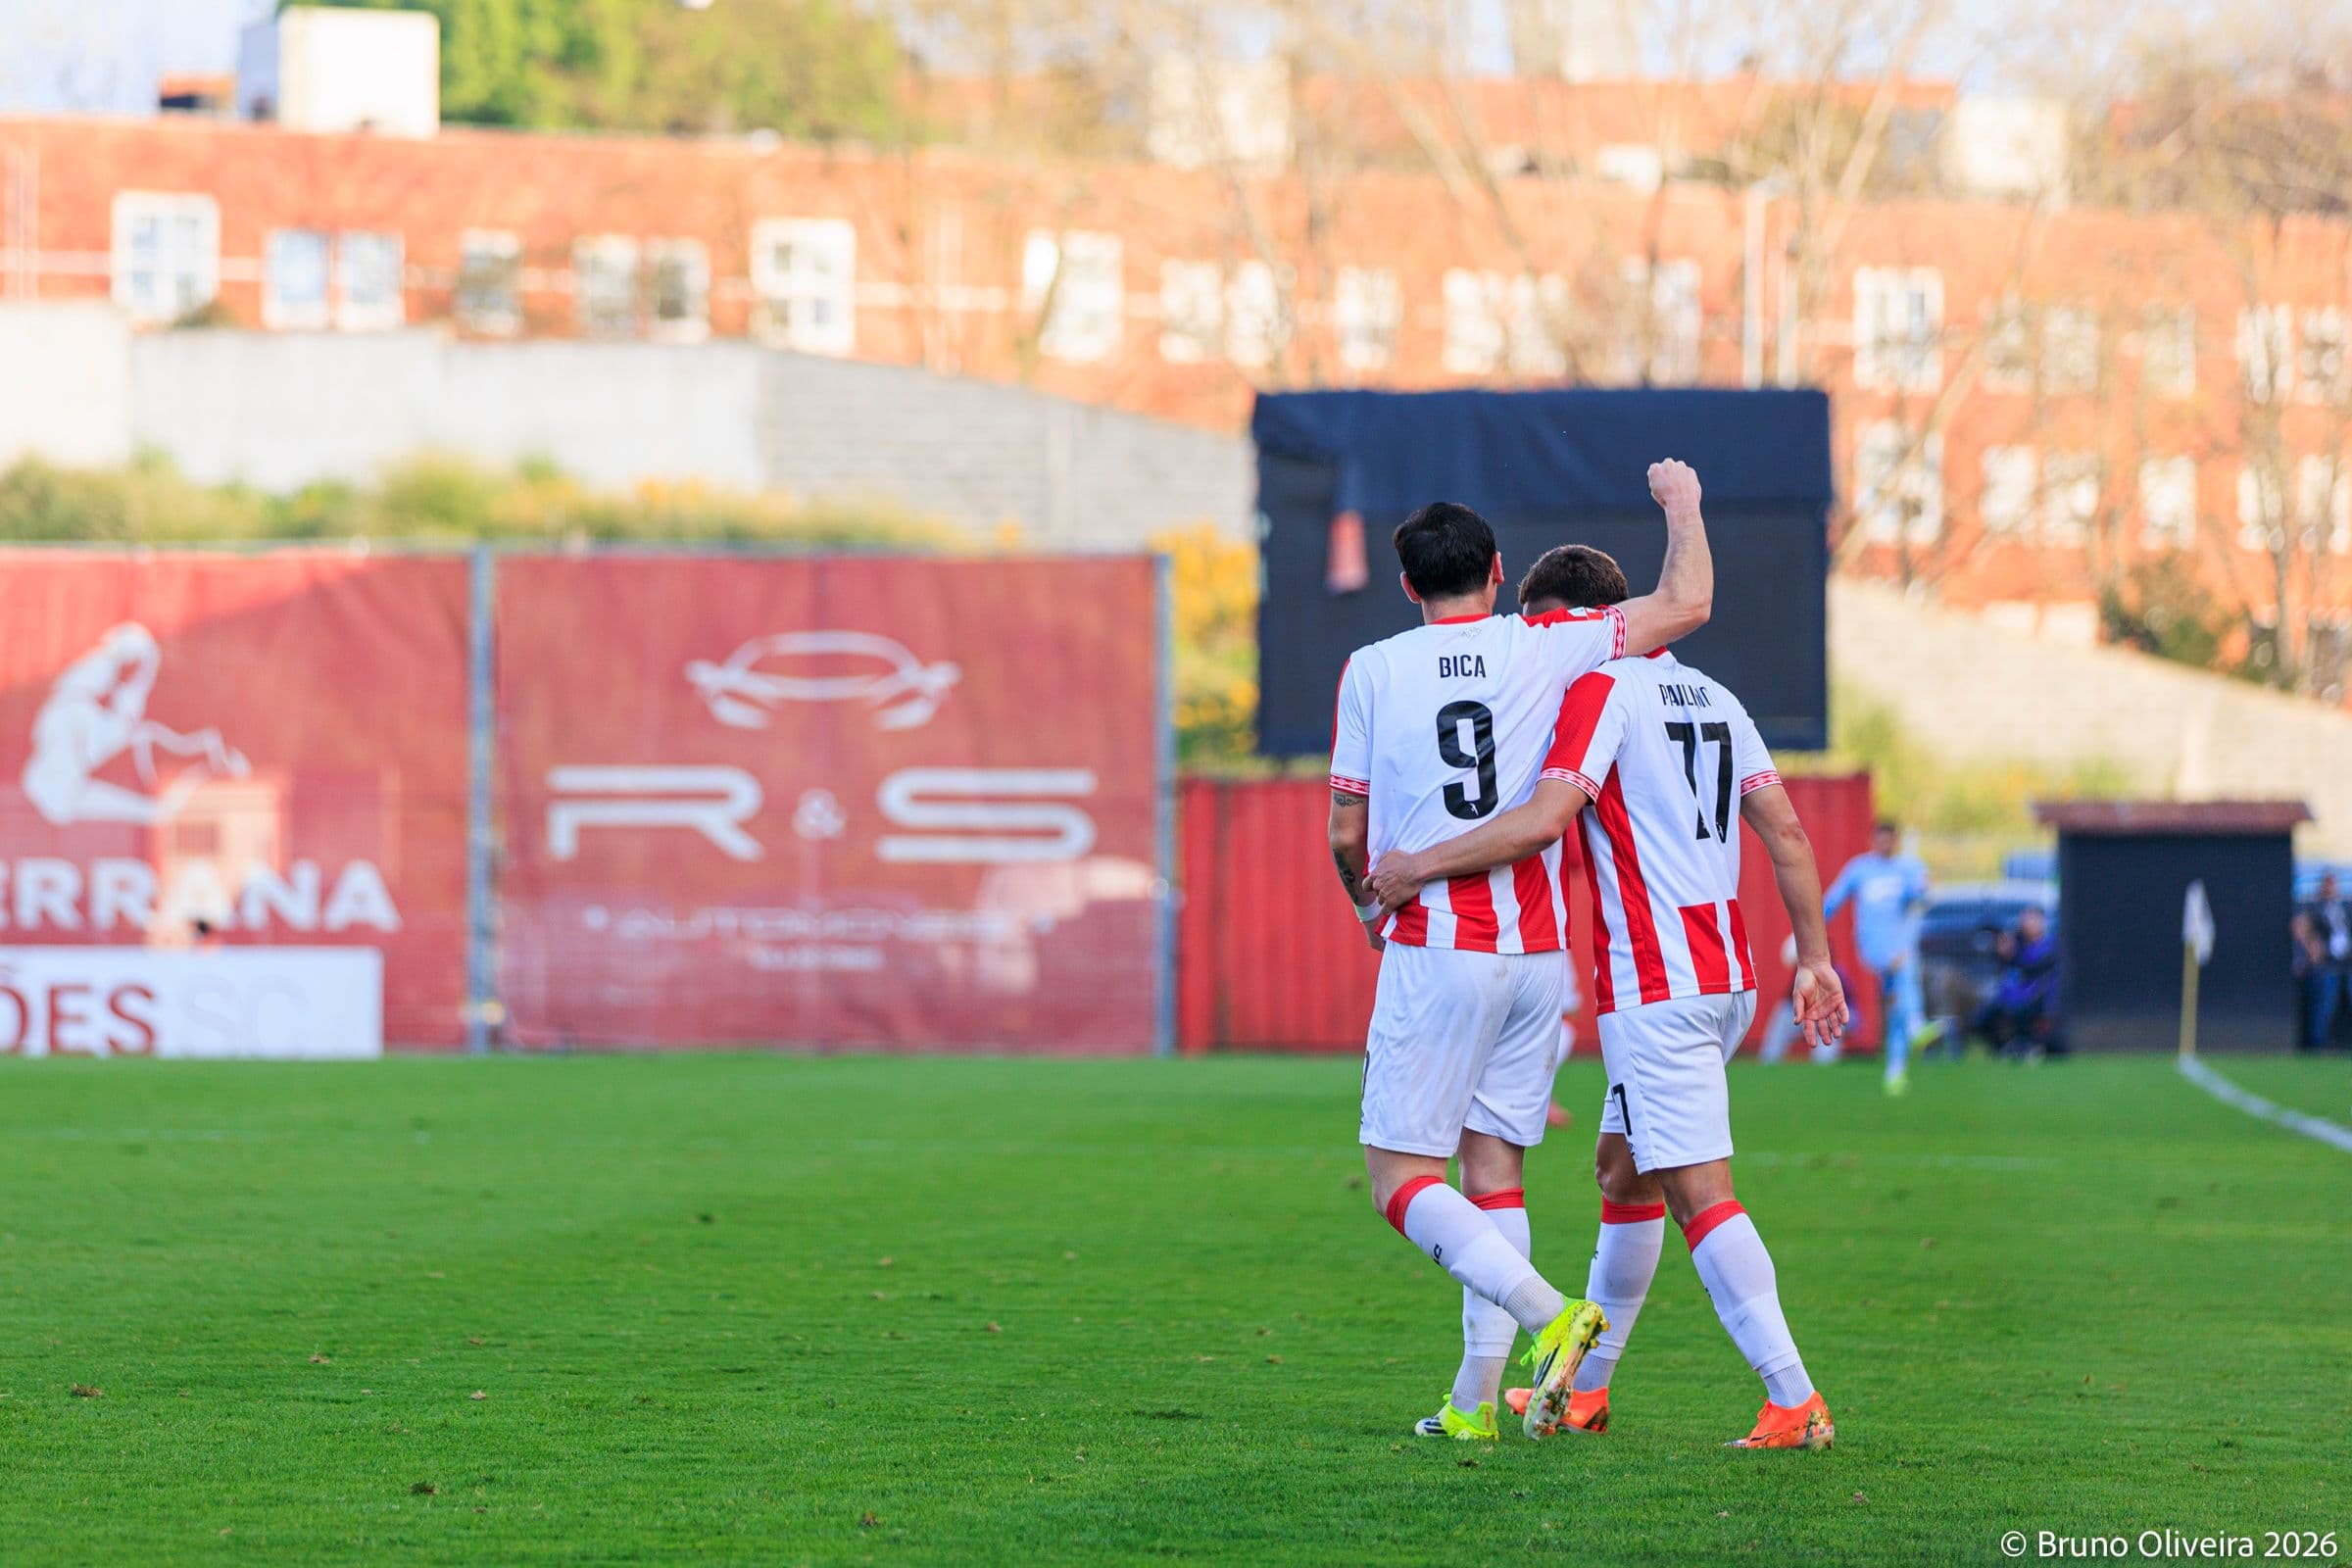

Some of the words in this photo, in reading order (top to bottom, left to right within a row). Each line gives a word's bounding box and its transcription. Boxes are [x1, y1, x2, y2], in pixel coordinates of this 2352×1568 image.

[1439, 654, 1487, 678] BICA
[1437, 701, 1498, 820] 9
[1664, 721, 1734, 844] 77
[548, 766, 762, 860] R
[875, 768, 1097, 862] S
[0, 857, 401, 932] RRANA
